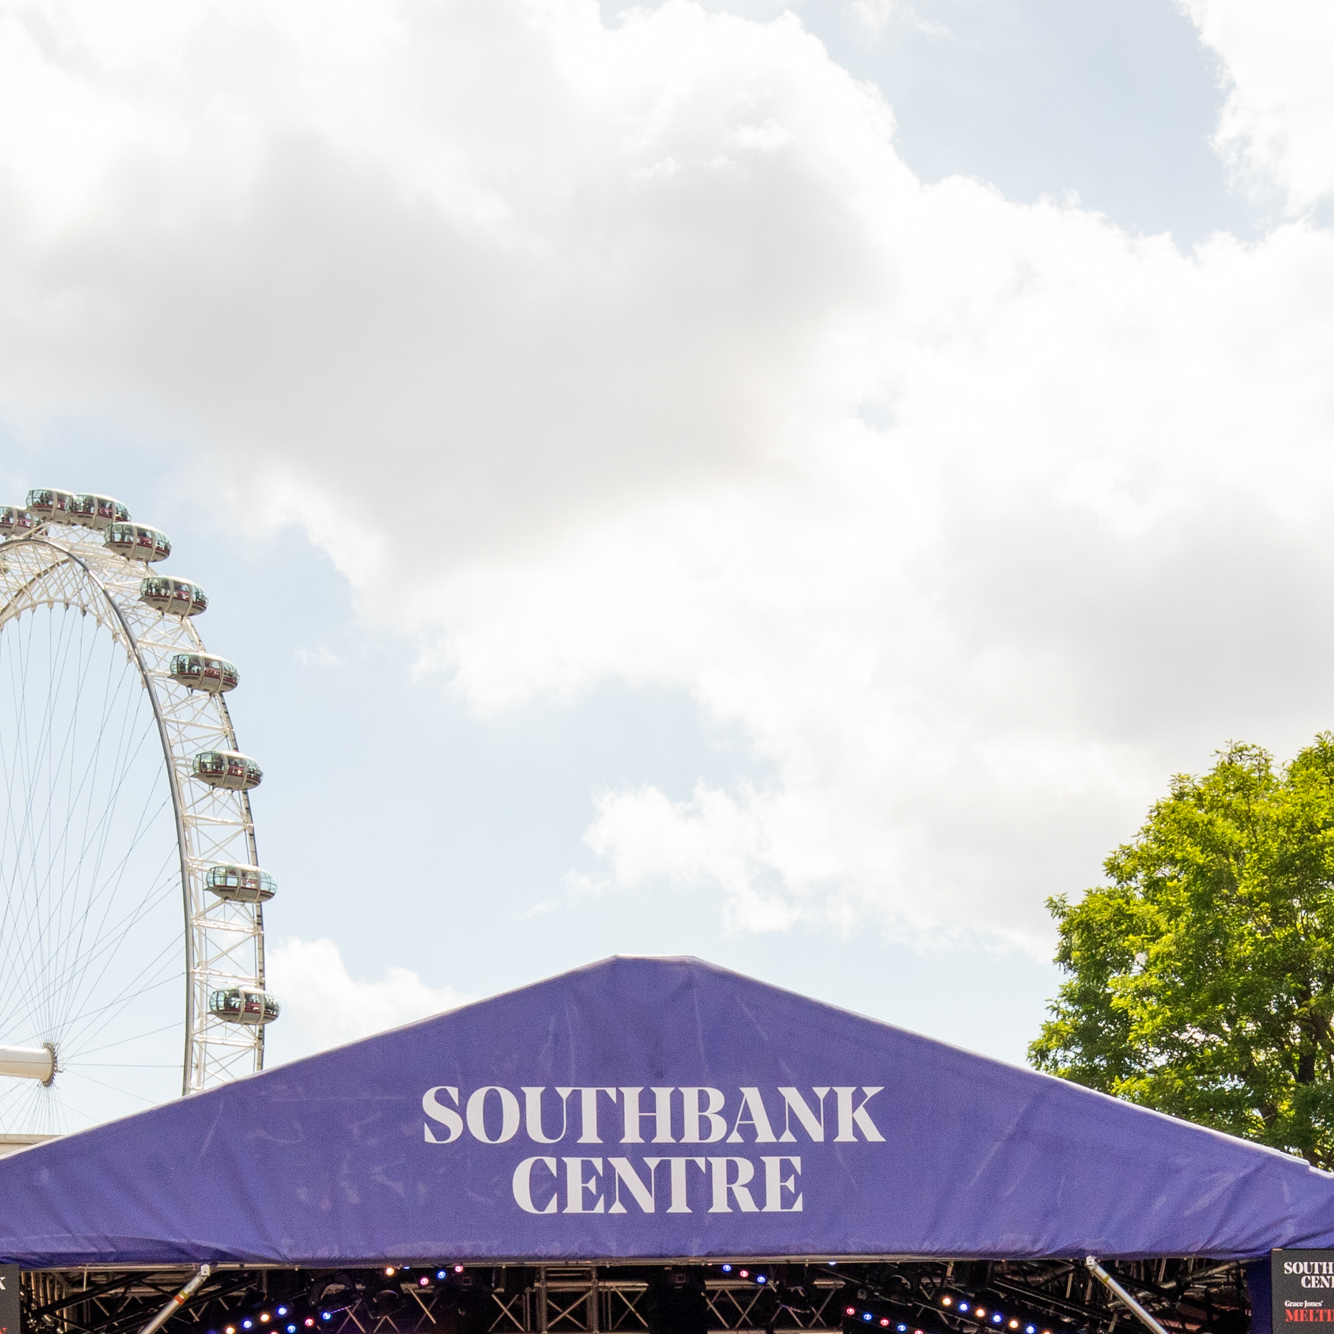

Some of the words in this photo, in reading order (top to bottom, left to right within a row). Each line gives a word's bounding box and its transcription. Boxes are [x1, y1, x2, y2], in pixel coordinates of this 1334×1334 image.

[421, 1085, 886, 1144] SOUTHBANK
[512, 1156, 803, 1214] CENTRE
[1284, 1300, 1304, 1308] Grace
